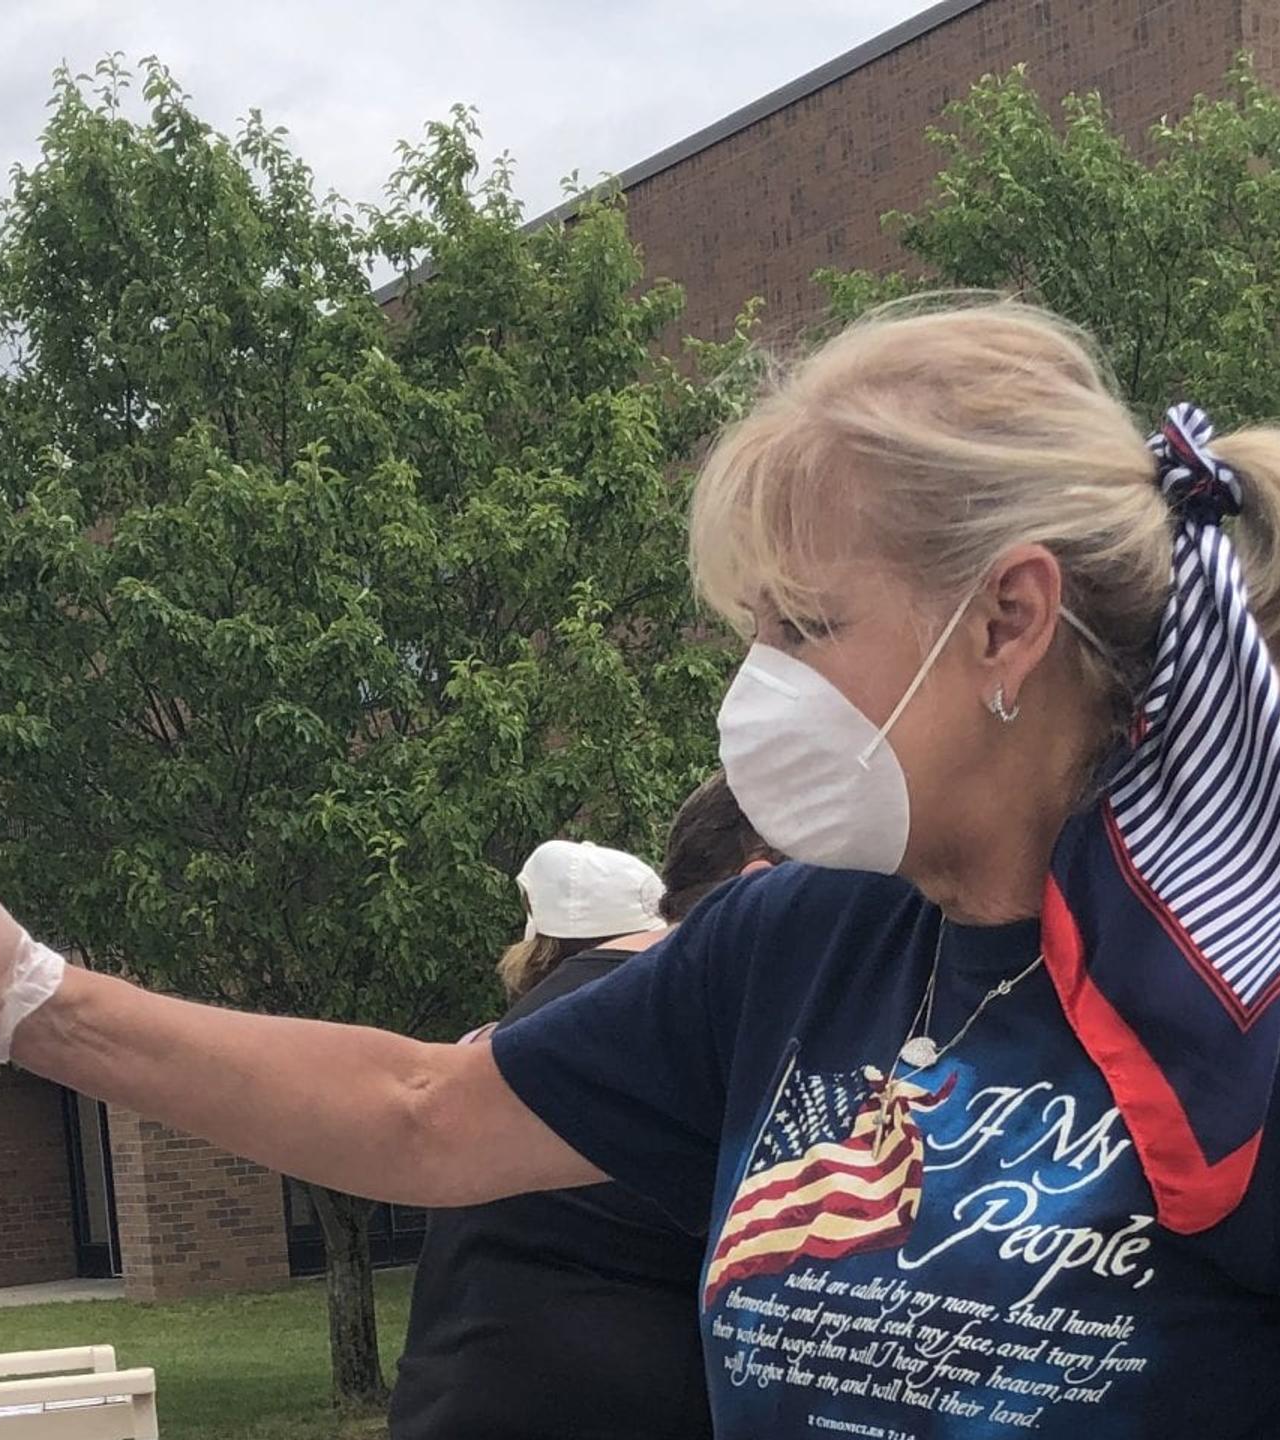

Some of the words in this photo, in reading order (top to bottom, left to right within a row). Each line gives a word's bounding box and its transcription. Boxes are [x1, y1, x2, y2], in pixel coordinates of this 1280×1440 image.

[922, 1081, 1053, 1173] If
[1000, 1094, 1133, 1194] My
[897, 1180, 1156, 1309] People,
[726, 1286, 791, 1322] themselves,
[784, 1267, 830, 1293] which
[826, 1279, 849, 1295] are
[850, 1277, 897, 1302] called
[881, 1280, 910, 1314] by
[907, 1289, 942, 1317] my
[942, 1295, 1000, 1322] name,
[1003, 1303, 1065, 1332] shall
[1062, 1310, 1135, 1339] humble
[791, 1301, 824, 1324] and
[712, 1315, 734, 1337] their
[736, 1323, 783, 1348] wicked
[811, 1309, 853, 1339] pray,
[852, 1313, 887, 1333] and
[880, 1315, 916, 1338] seek
[817, 1337, 850, 1361] then
[915, 1324, 950, 1352] my
[917, 1320, 994, 1358] face,
[996, 1339, 1049, 1363] and
[849, 1342, 877, 1365] will
[871, 1340, 898, 1368] I
[892, 1347, 928, 1374] hear
[1046, 1346, 1095, 1370] turn
[1064, 1341, 1147, 1384] from
[906, 1349, 981, 1388] from
[724, 1350, 748, 1387] will
[746, 1347, 785, 1389] forgive
[785, 1362, 816, 1385] their
[815, 1370, 841, 1396] sin,
[840, 1374, 872, 1396] and
[871, 1377, 903, 1402] will
[900, 1382, 940, 1410] heal
[938, 1390, 985, 1418] their
[988, 1400, 1044, 1430] land.
[985, 1365, 1064, 1404] heaven,
[1063, 1380, 1112, 1404] and
